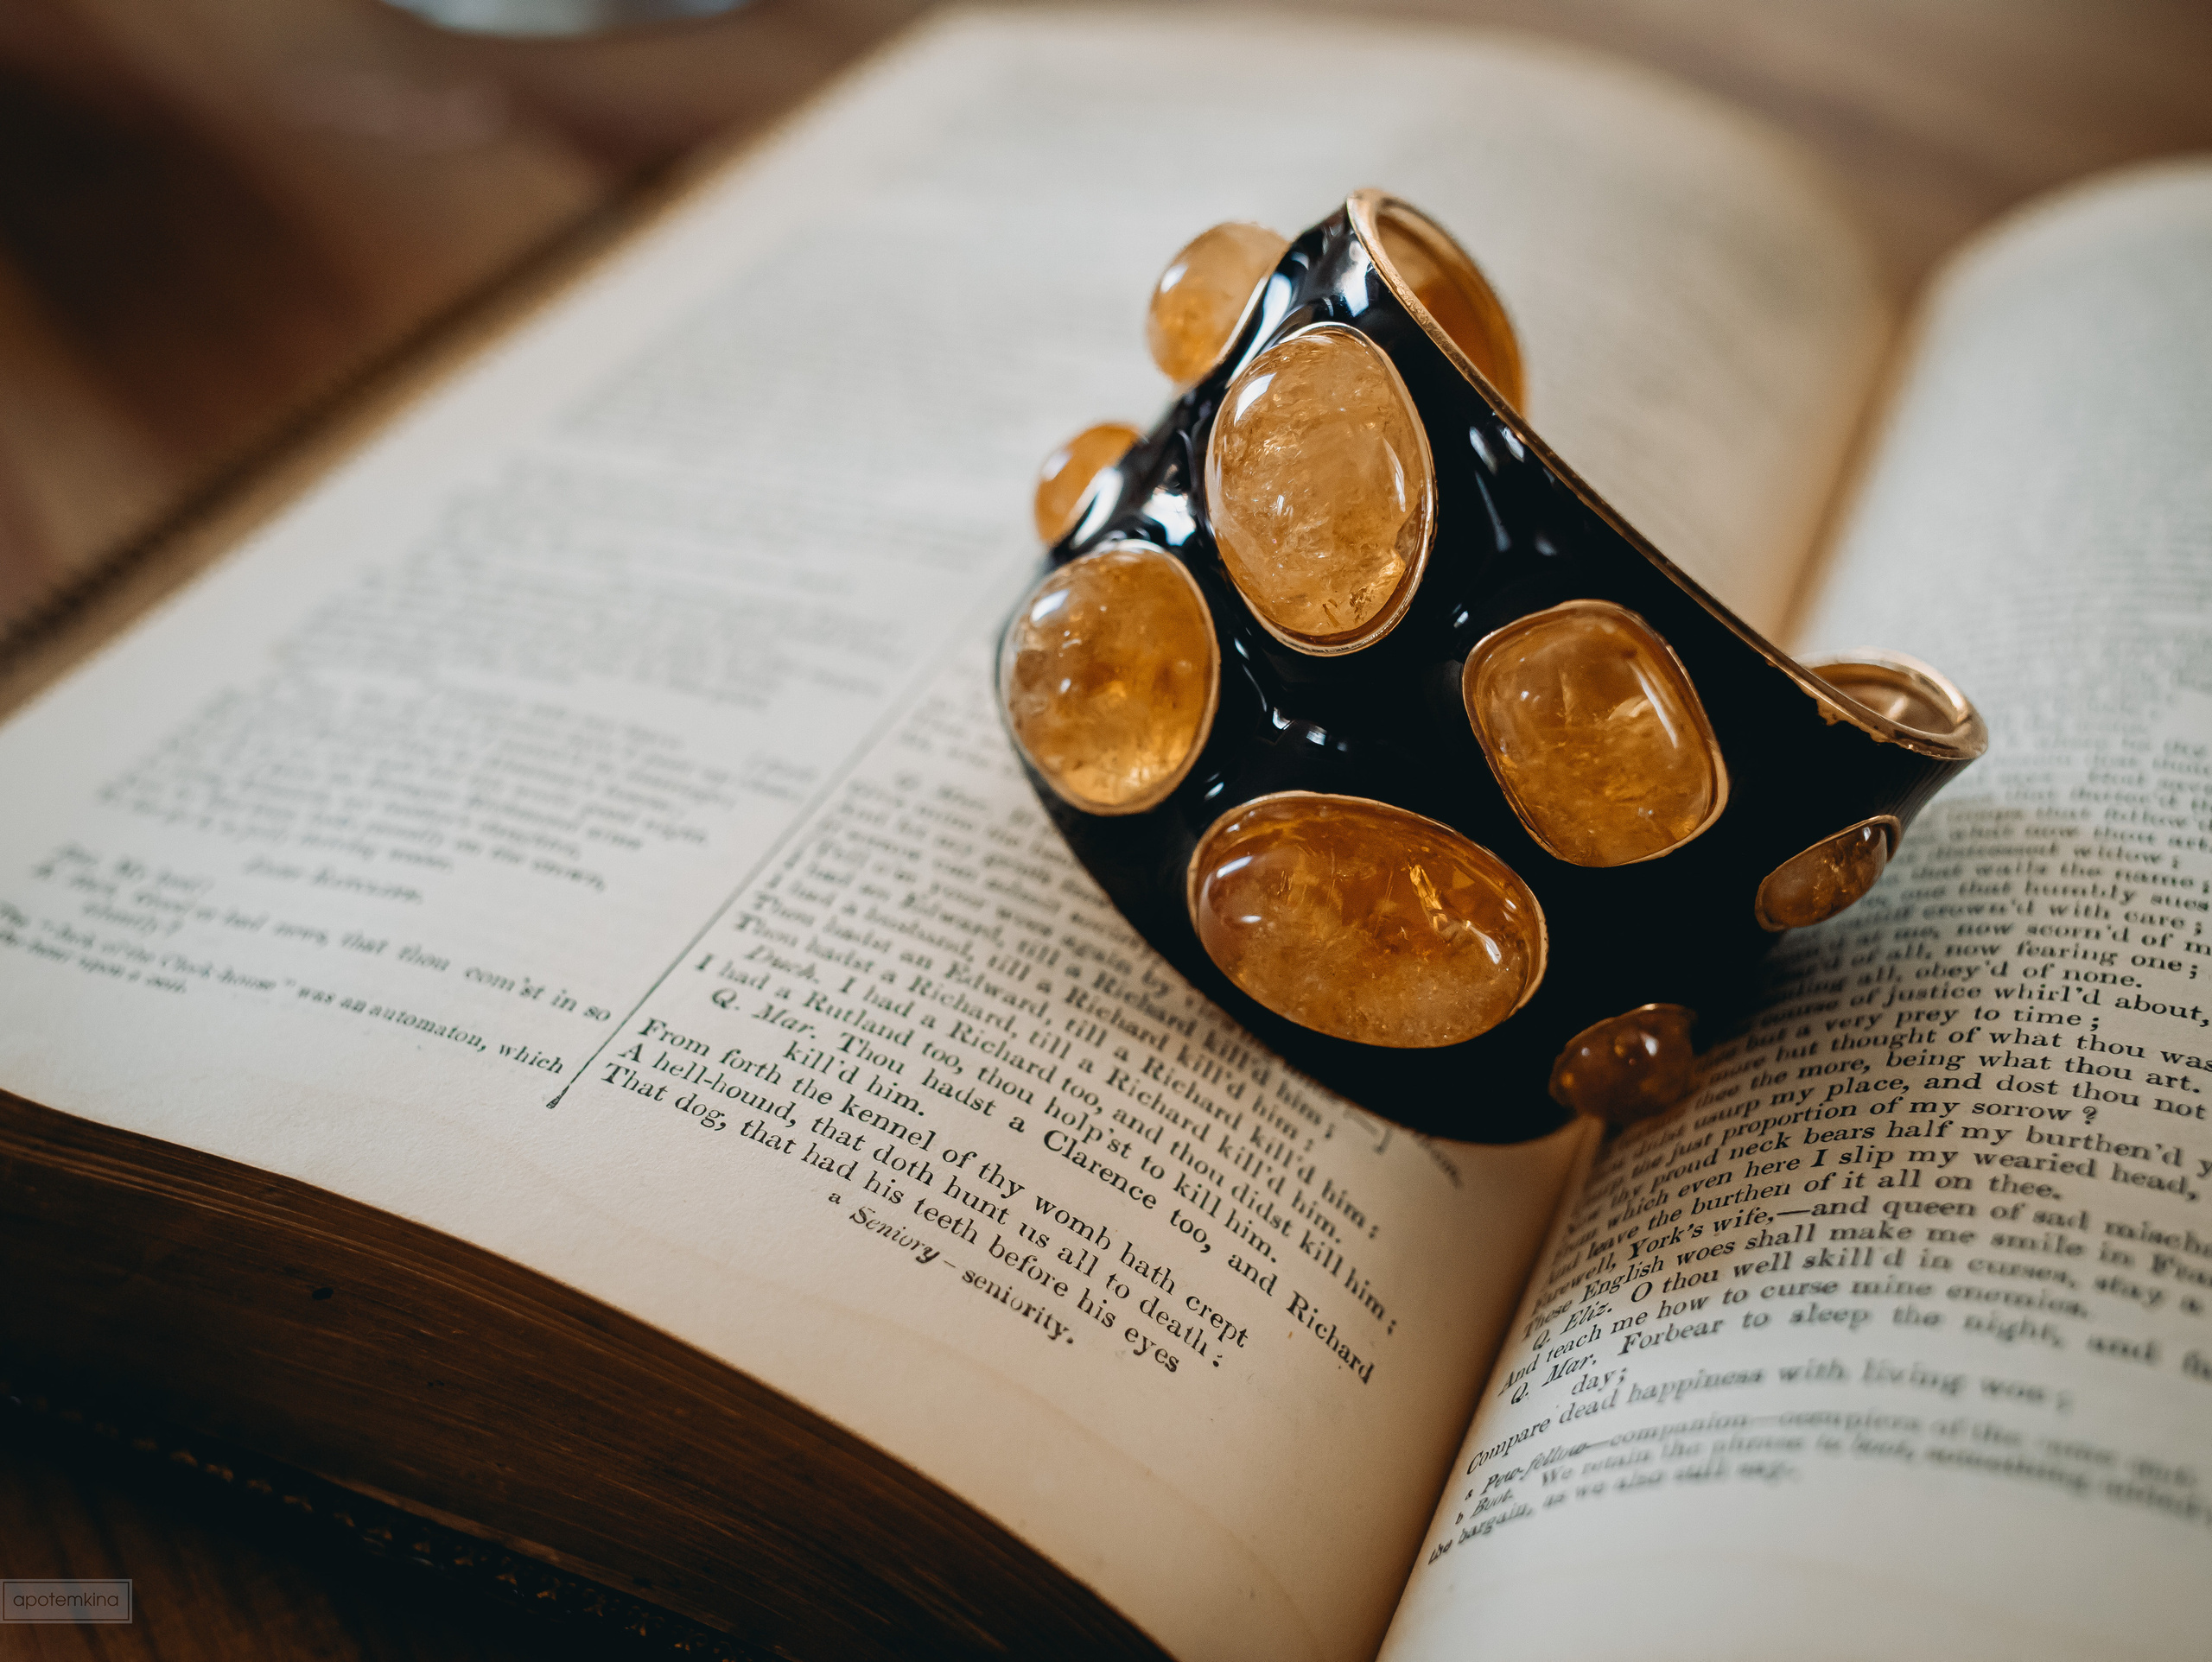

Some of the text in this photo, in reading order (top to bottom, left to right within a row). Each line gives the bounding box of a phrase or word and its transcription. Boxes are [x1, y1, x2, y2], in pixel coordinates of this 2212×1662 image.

[1946, 945, 1999, 957] now
[2017, 941, 2118, 966] fearing
[2027, 925, 2173, 948] scorn'd of
[398, 942, 451, 973] thou
[551, 989, 577, 1012] in
[583, 1006, 611, 1021] so
[1882, 981, 2209, 1027] justice whirl'd about,
[1916, 960, 2142, 988] obey'd of none.
[299, 986, 563, 1074] was an automaton, which
[1826, 1013, 1882, 1031] very
[1895, 1010, 1959, 1029] prey
[1974, 1006, 1999, 1021] to
[1831, 1026, 1936, 1054] thought
[1948, 1027, 1981, 1044] of
[1989, 1028, 2063, 1047] what
[2077, 1034, 2145, 1058] thou
[783, 1041, 924, 1116] kill'd him.
[1106, 1068, 1210, 1142] Richard
[1770, 1073, 2206, 1120] my place, and dost thou not
[1796, 1048, 2200, 1094] more, being what thou art.
[696, 954, 1276, 1263] I had Rutland too, thou holp'st to kill him.
[1721, 1102, 1857, 1147] proportion
[1870, 1096, 1904, 1114] of
[1909, 1102, 1961, 1118] my
[618, 1044, 643, 1063] A
[652, 1051, 796, 1127] hell-hound,
[811, 1118, 866, 1151] that
[874, 1145, 933, 1186] doth
[943, 1175, 1009, 1225] hunt
[1020, 1222, 1050, 1247] us
[1058, 1248, 1098, 1278] all
[1106, 1273, 1129, 1298] to
[639, 1018, 1248, 1348] From forth the kennel of thy womb hath crept
[949, 1021, 1057, 1083] Richard
[1061, 1078, 1103, 1114] too,
[1113, 1109, 1164, 1145] and
[1170, 1141, 1224, 1187] thou
[1231, 1184, 1292, 1236] didst
[1300, 1230, 1343, 1277] kill
[1651, 1120, 2183, 1193] proud neck bears half my burthen'd
[1678, 1145, 2199, 1202] even here I slip my wearied head,
[601, 1063, 1179, 1373] That dog, that had his teeth before his eyes
[712, 989, 1375, 1385] Q. Mar. Thou hadst a Clarence too, and Richard
[829, 1193, 841, 1204] a
[1648, 1169, 2062, 1230] the burthen of it all on thee.
[1580, 1219, 1975, 1304] English woes shall make me
[1628, 1222, 1704, 1261] York's
[1883, 1201, 1977, 1221] queen
[1990, 1203, 2025, 1221] of
[2033, 1210, 2089, 1231] sad
[1533, 1247, 1903, 1351] Q. Eliz. O thou well skill'd
[1498, 1283, 1838, 1396] And teach me how to curse
[1511, 1312, 1770, 1405] Q. Mar. Forbear to
[1467, 1418, 1550, 1475] Compare
[1559, 1389, 1618, 1424] dead
[1628, 1371, 1764, 1403] happiness
[1780, 1361, 1845, 1381] with
[1864, 1362, 1961, 1396] living
[1572, 1368, 1626, 1395] day;
